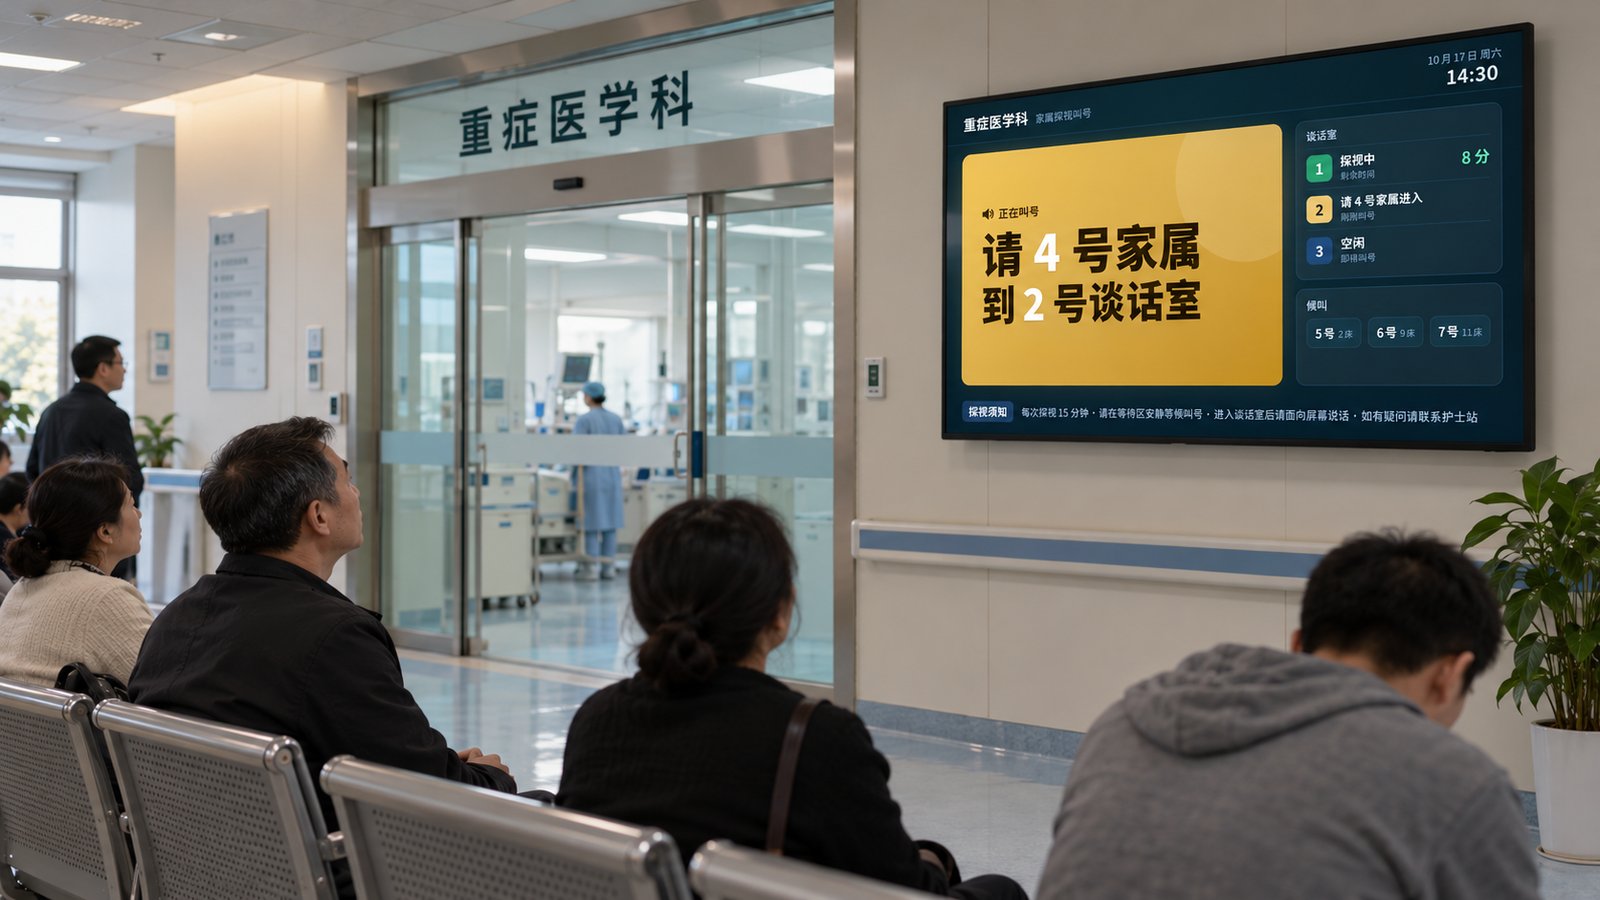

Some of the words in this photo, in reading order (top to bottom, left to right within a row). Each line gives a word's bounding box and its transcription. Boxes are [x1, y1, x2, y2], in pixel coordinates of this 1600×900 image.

[1480, 48, 1502, 59] 周六
[1447, 65, 1498, 85] 14:30
[460, 70, 693, 157] 重症医学科
[964, 111, 1028, 132] 重症医学科
[1306, 129, 1336, 142] 谈话室
[1340, 153, 1374, 167] 探视中
[1461, 151, 1471, 165] 8
[1475, 149, 1489, 164] 分
[1315, 163, 1324, 176] 1
[999, 206, 1039, 219] 正在叫号
[1315, 204, 1324, 217] 2
[983, 231, 1022, 277] 请
[1033, 232, 1060, 272] 4
[1073, 222, 1199, 273] 号家属
[1341, 237, 1364, 249] 空闲
[1315, 245, 1324, 258] 3
[983, 285, 1014, 324] 到
[1023, 288, 1045, 321] 2
[1054, 279, 1200, 323] 号谈话室
[1316, 328, 1334, 339] 5号
[1338, 330, 1353, 339] 2床
[1377, 327, 1396, 338] 6号
[1400, 328, 1415, 338] 9床
[1439, 326, 1458, 338] 7号
[1462, 327, 1483, 337] 11床
[969, 406, 1007, 417] 探视须知
[1059, 408, 1068, 417] 15
